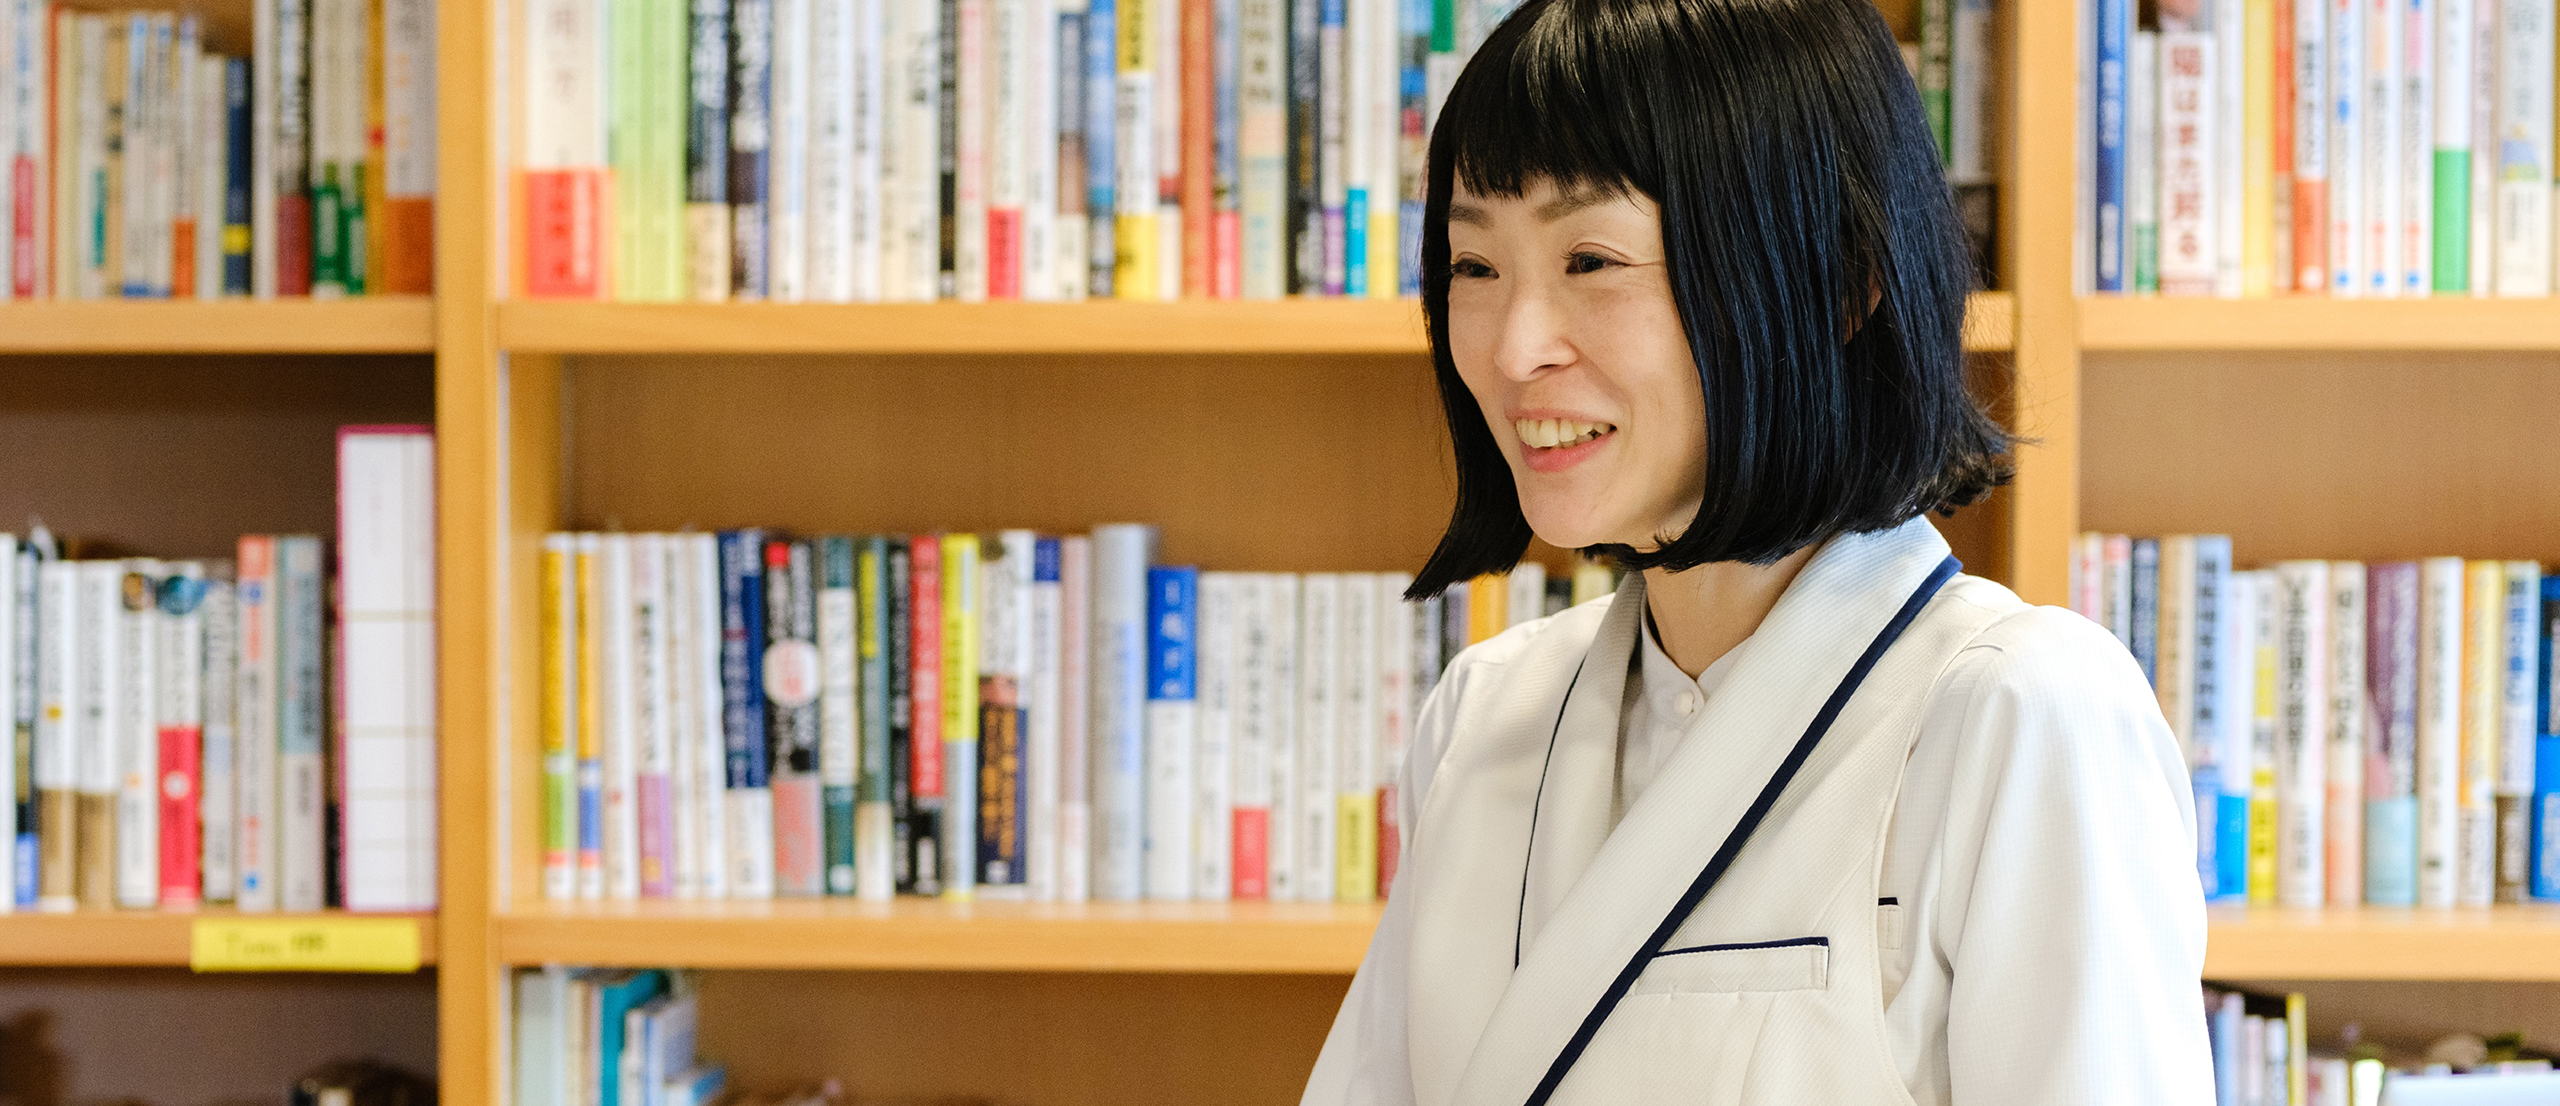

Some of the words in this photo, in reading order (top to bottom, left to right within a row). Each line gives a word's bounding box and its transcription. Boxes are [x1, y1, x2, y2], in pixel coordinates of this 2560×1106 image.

[2170, 46, 2203, 257] 陽はまた昇る
